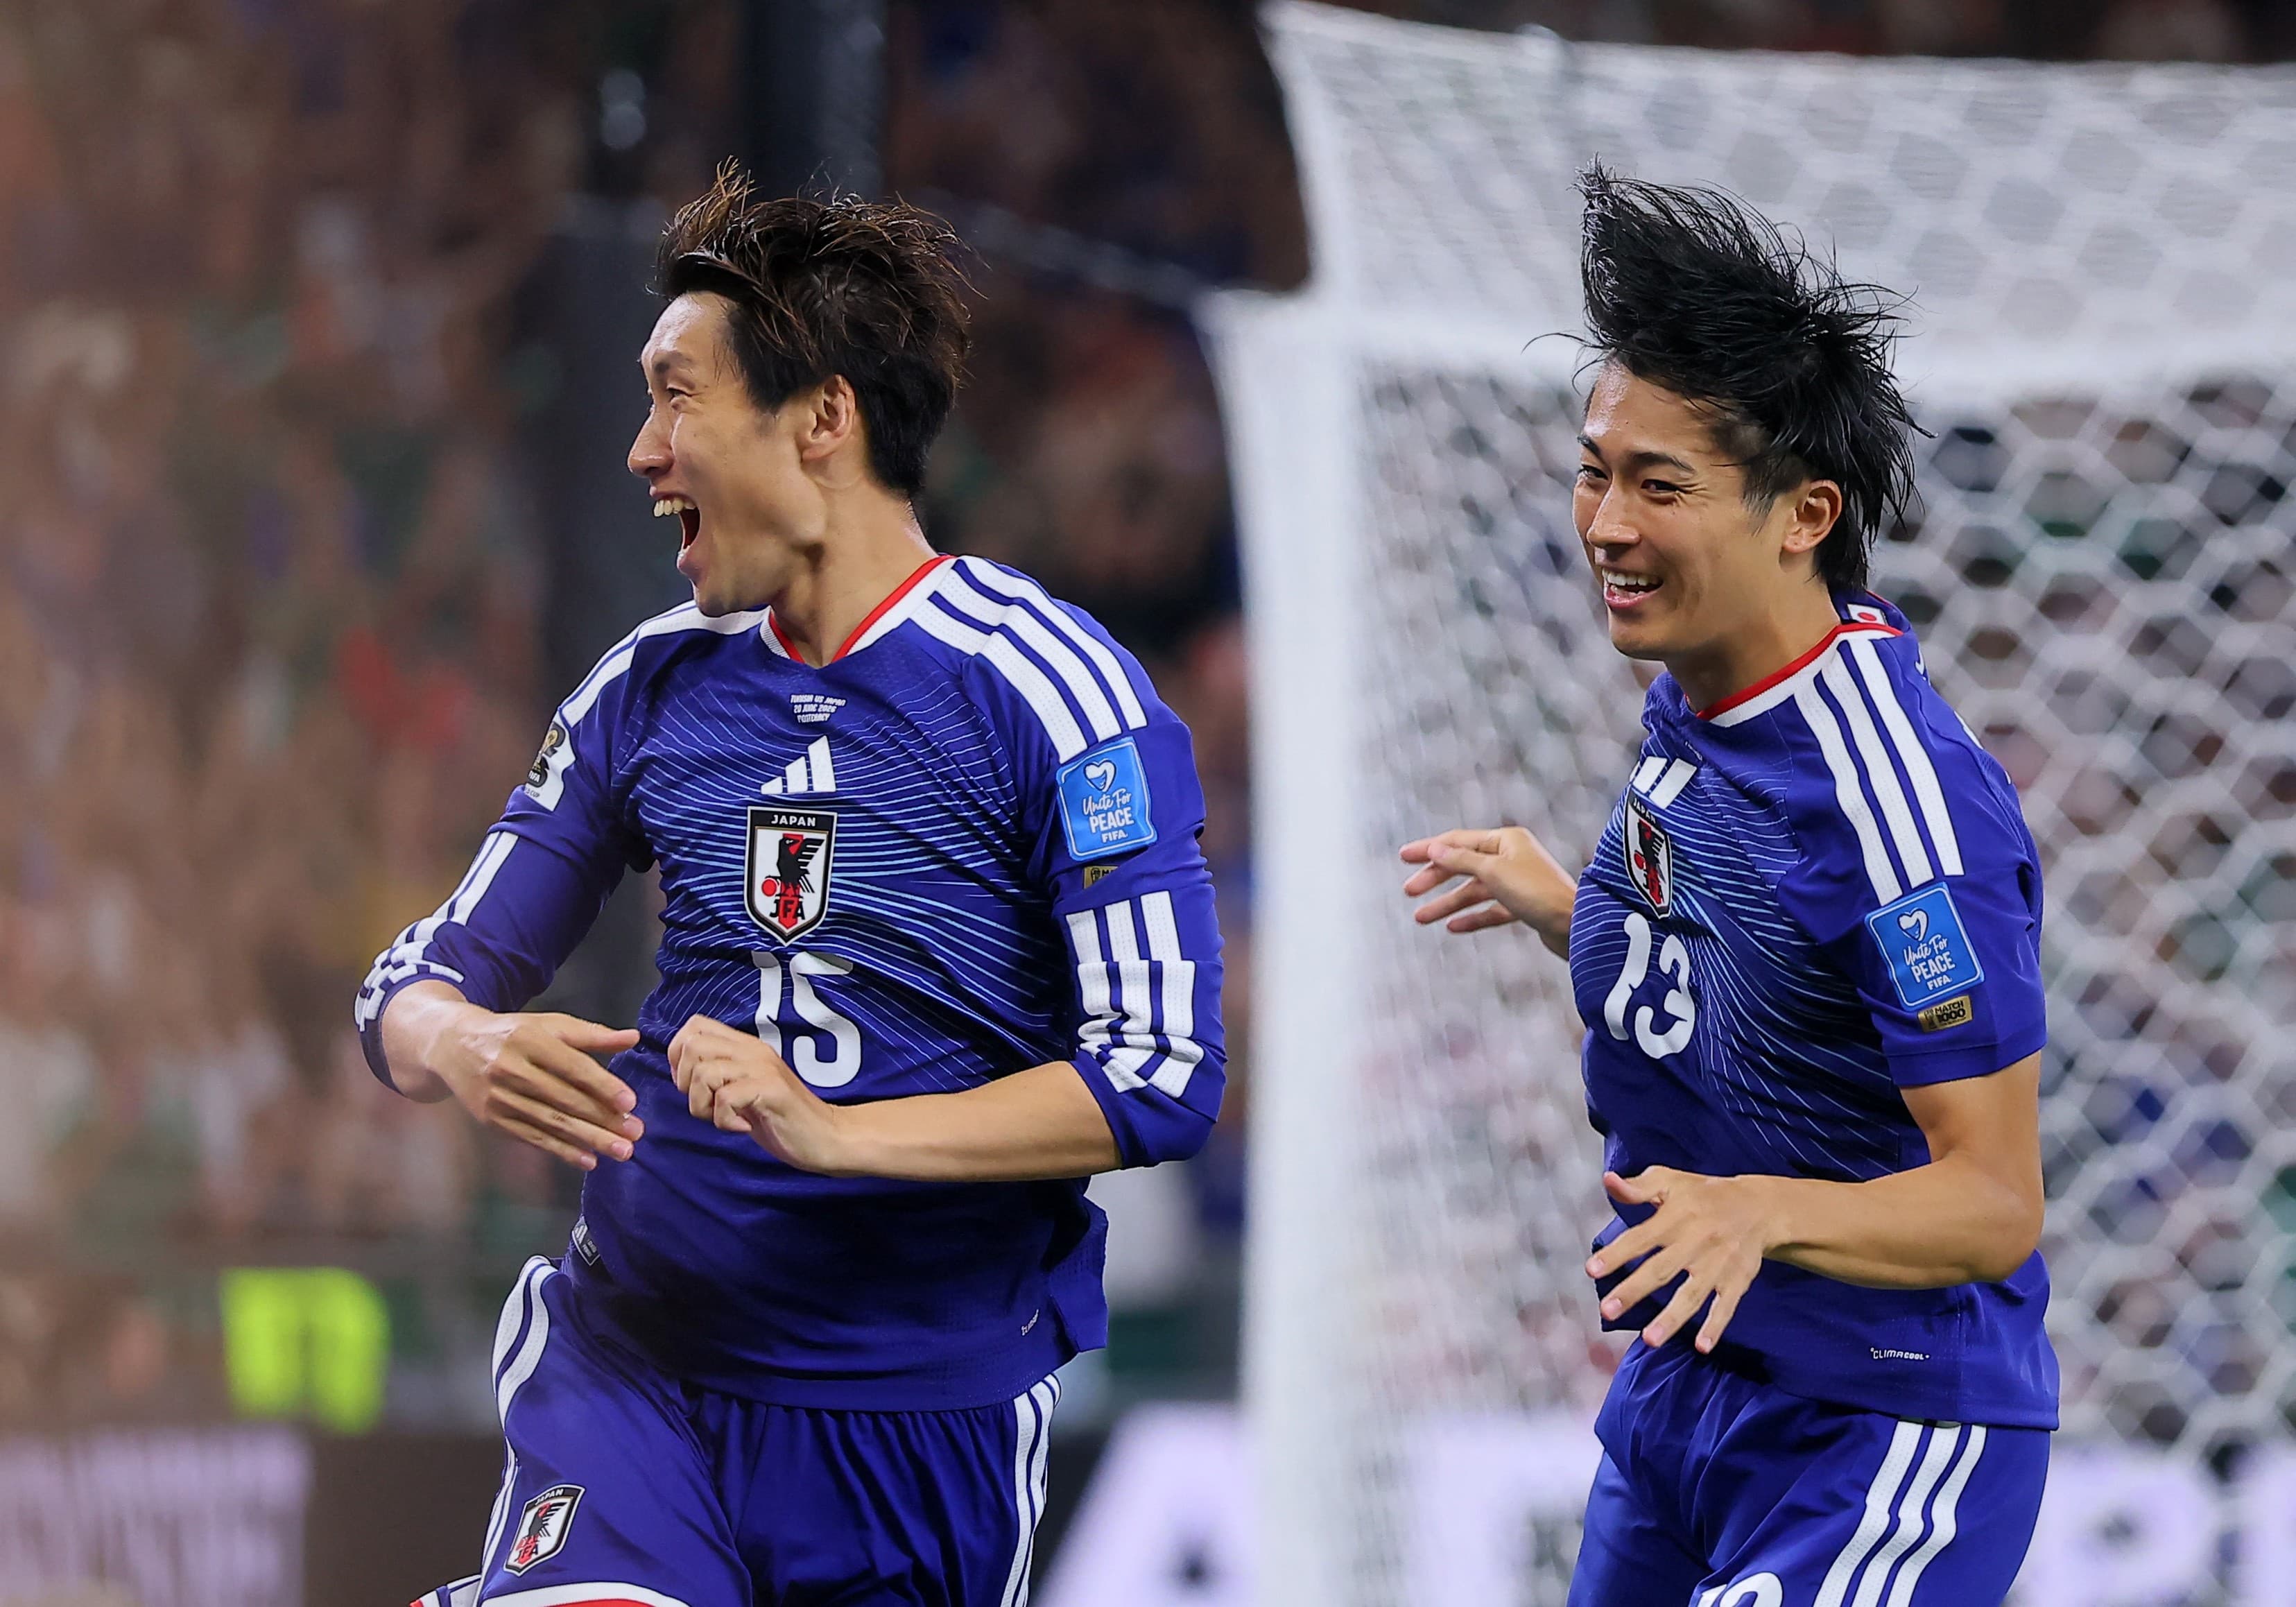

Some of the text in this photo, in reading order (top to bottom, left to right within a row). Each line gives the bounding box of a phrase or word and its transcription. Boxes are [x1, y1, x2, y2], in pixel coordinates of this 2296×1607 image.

[794, 704, 802, 714] 20
[818, 704, 837, 714] 2026
[824, 697, 846, 706] JAPAN
[1082, 789, 1132, 816] Unite For
[1633, 798, 1657, 824] JAPAN
[770, 814, 816, 827] JAPAN
[1089, 807, 1134, 833] PEACE
[1101, 831, 1128, 843] FIFA
[769, 899, 805, 920] JFA
[1904, 934, 1948, 965] Unite For
[1910, 952, 1956, 983] PEACE
[1604, 912, 1695, 1060] 13
[1926, 974, 1952, 990] FIFA
[751, 951, 861, 1081] 15
[1935, 1000, 1964, 1014] MATCH
[534, 1488, 564, 1506] JAPAN
[514, 1544, 538, 1562] JFA
